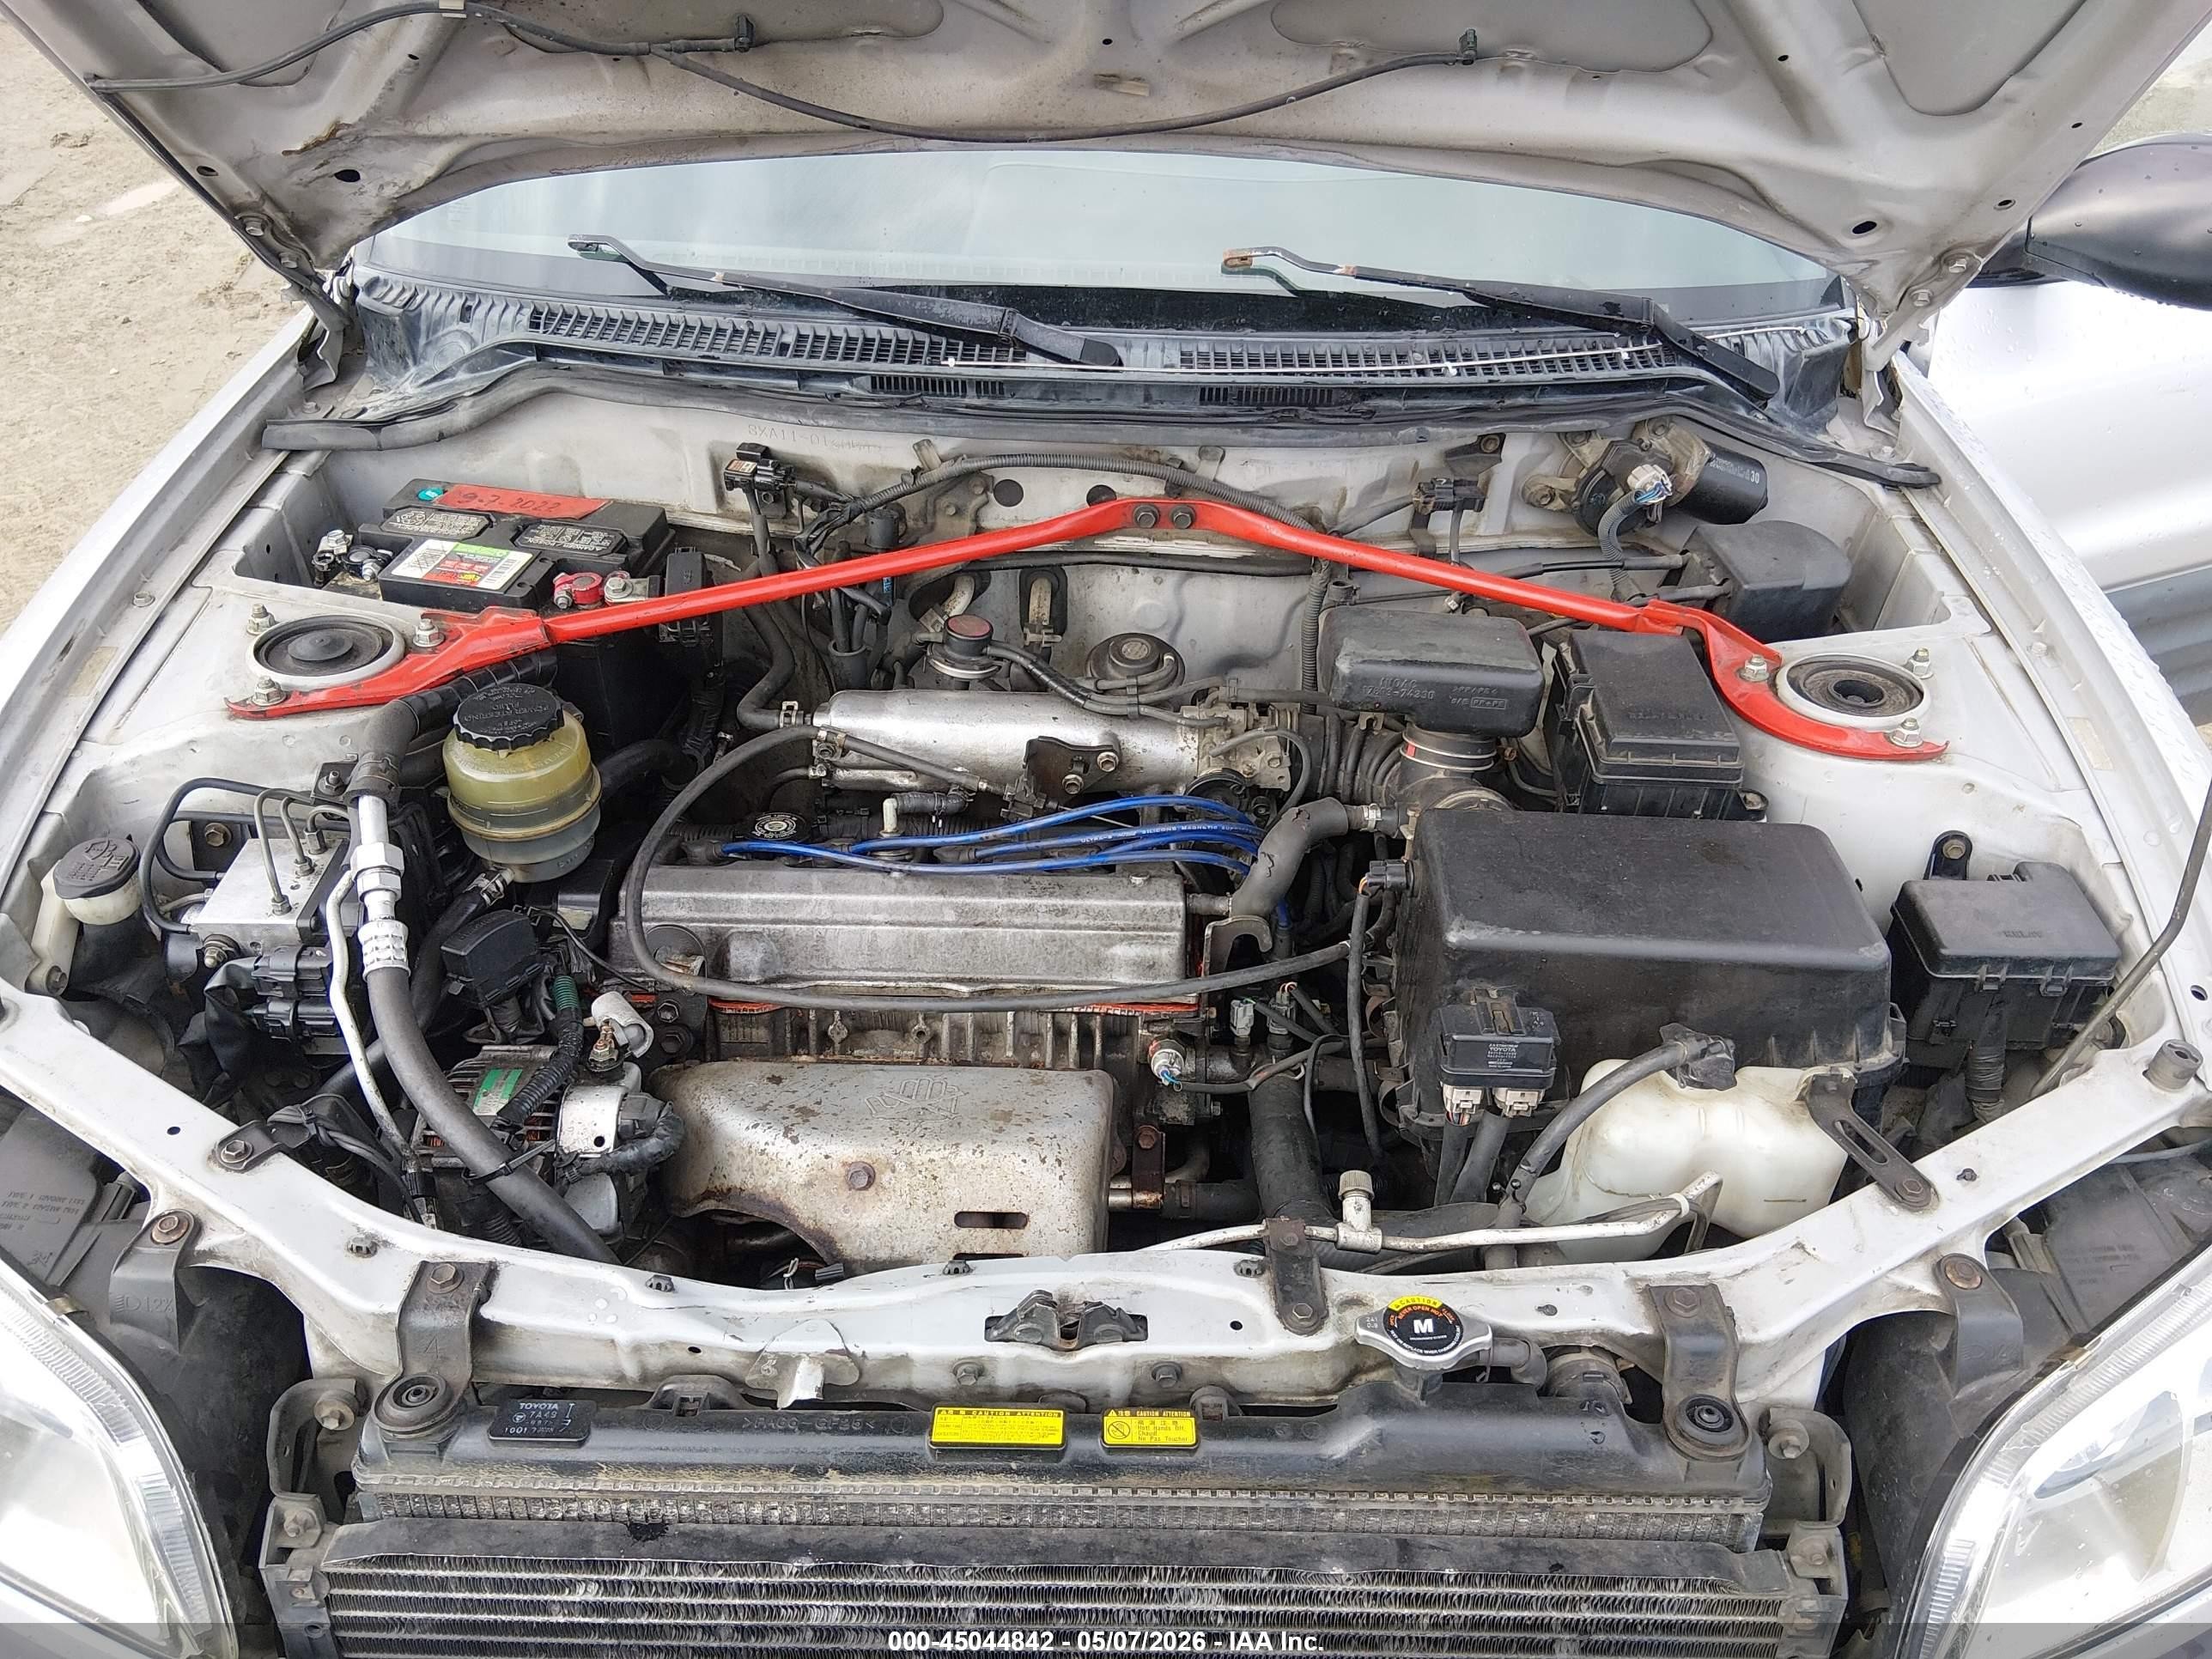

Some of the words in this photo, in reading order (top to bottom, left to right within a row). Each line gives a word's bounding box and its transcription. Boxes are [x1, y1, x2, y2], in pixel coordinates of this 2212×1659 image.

[1400, 1297, 1437, 1306] CAUTION
[1430, 1308, 1443, 1317] HOT
[1413, 1318, 1434, 1334] M
